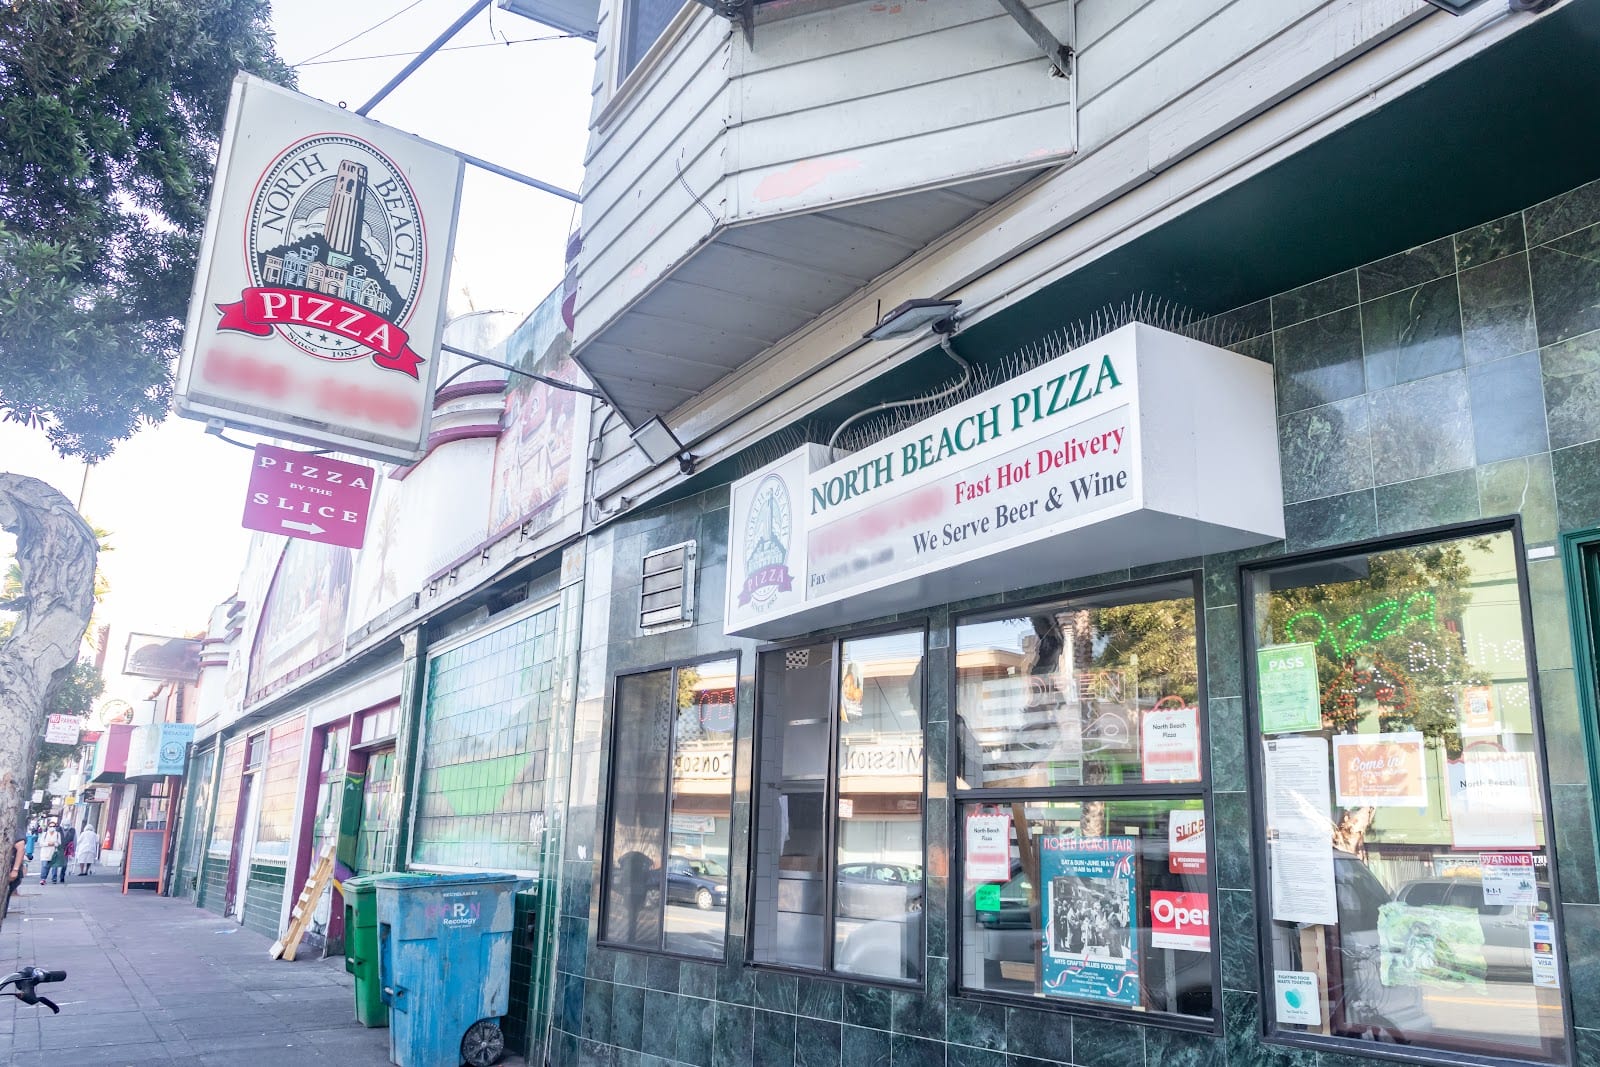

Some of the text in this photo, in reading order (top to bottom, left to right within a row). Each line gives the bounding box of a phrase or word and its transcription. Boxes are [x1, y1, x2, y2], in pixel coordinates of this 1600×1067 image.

[261, 152, 416, 275] NORTH BEACH
[259, 292, 392, 353] PIZZA
[286, 331, 317, 353] Since
[810, 353, 1123, 516] NORTH BEACH PIZZA
[257, 456, 369, 490] PIZZA
[954, 426, 1126, 505] Fast Hot Delivery
[289, 482, 333, 497] BY THE
[252, 492, 358, 523] SLICE
[913, 470, 1127, 554] We Serve Beer & Wine
[747, 568, 785, 593] PIZZA
[810, 572, 826, 587] Fax
[1268, 656, 1304, 671] PASS
[1352, 757, 1384, 772] Come
[1044, 838, 1132, 852] NORTH BEACH FAIR
[1482, 856, 1530, 864] WARNING
